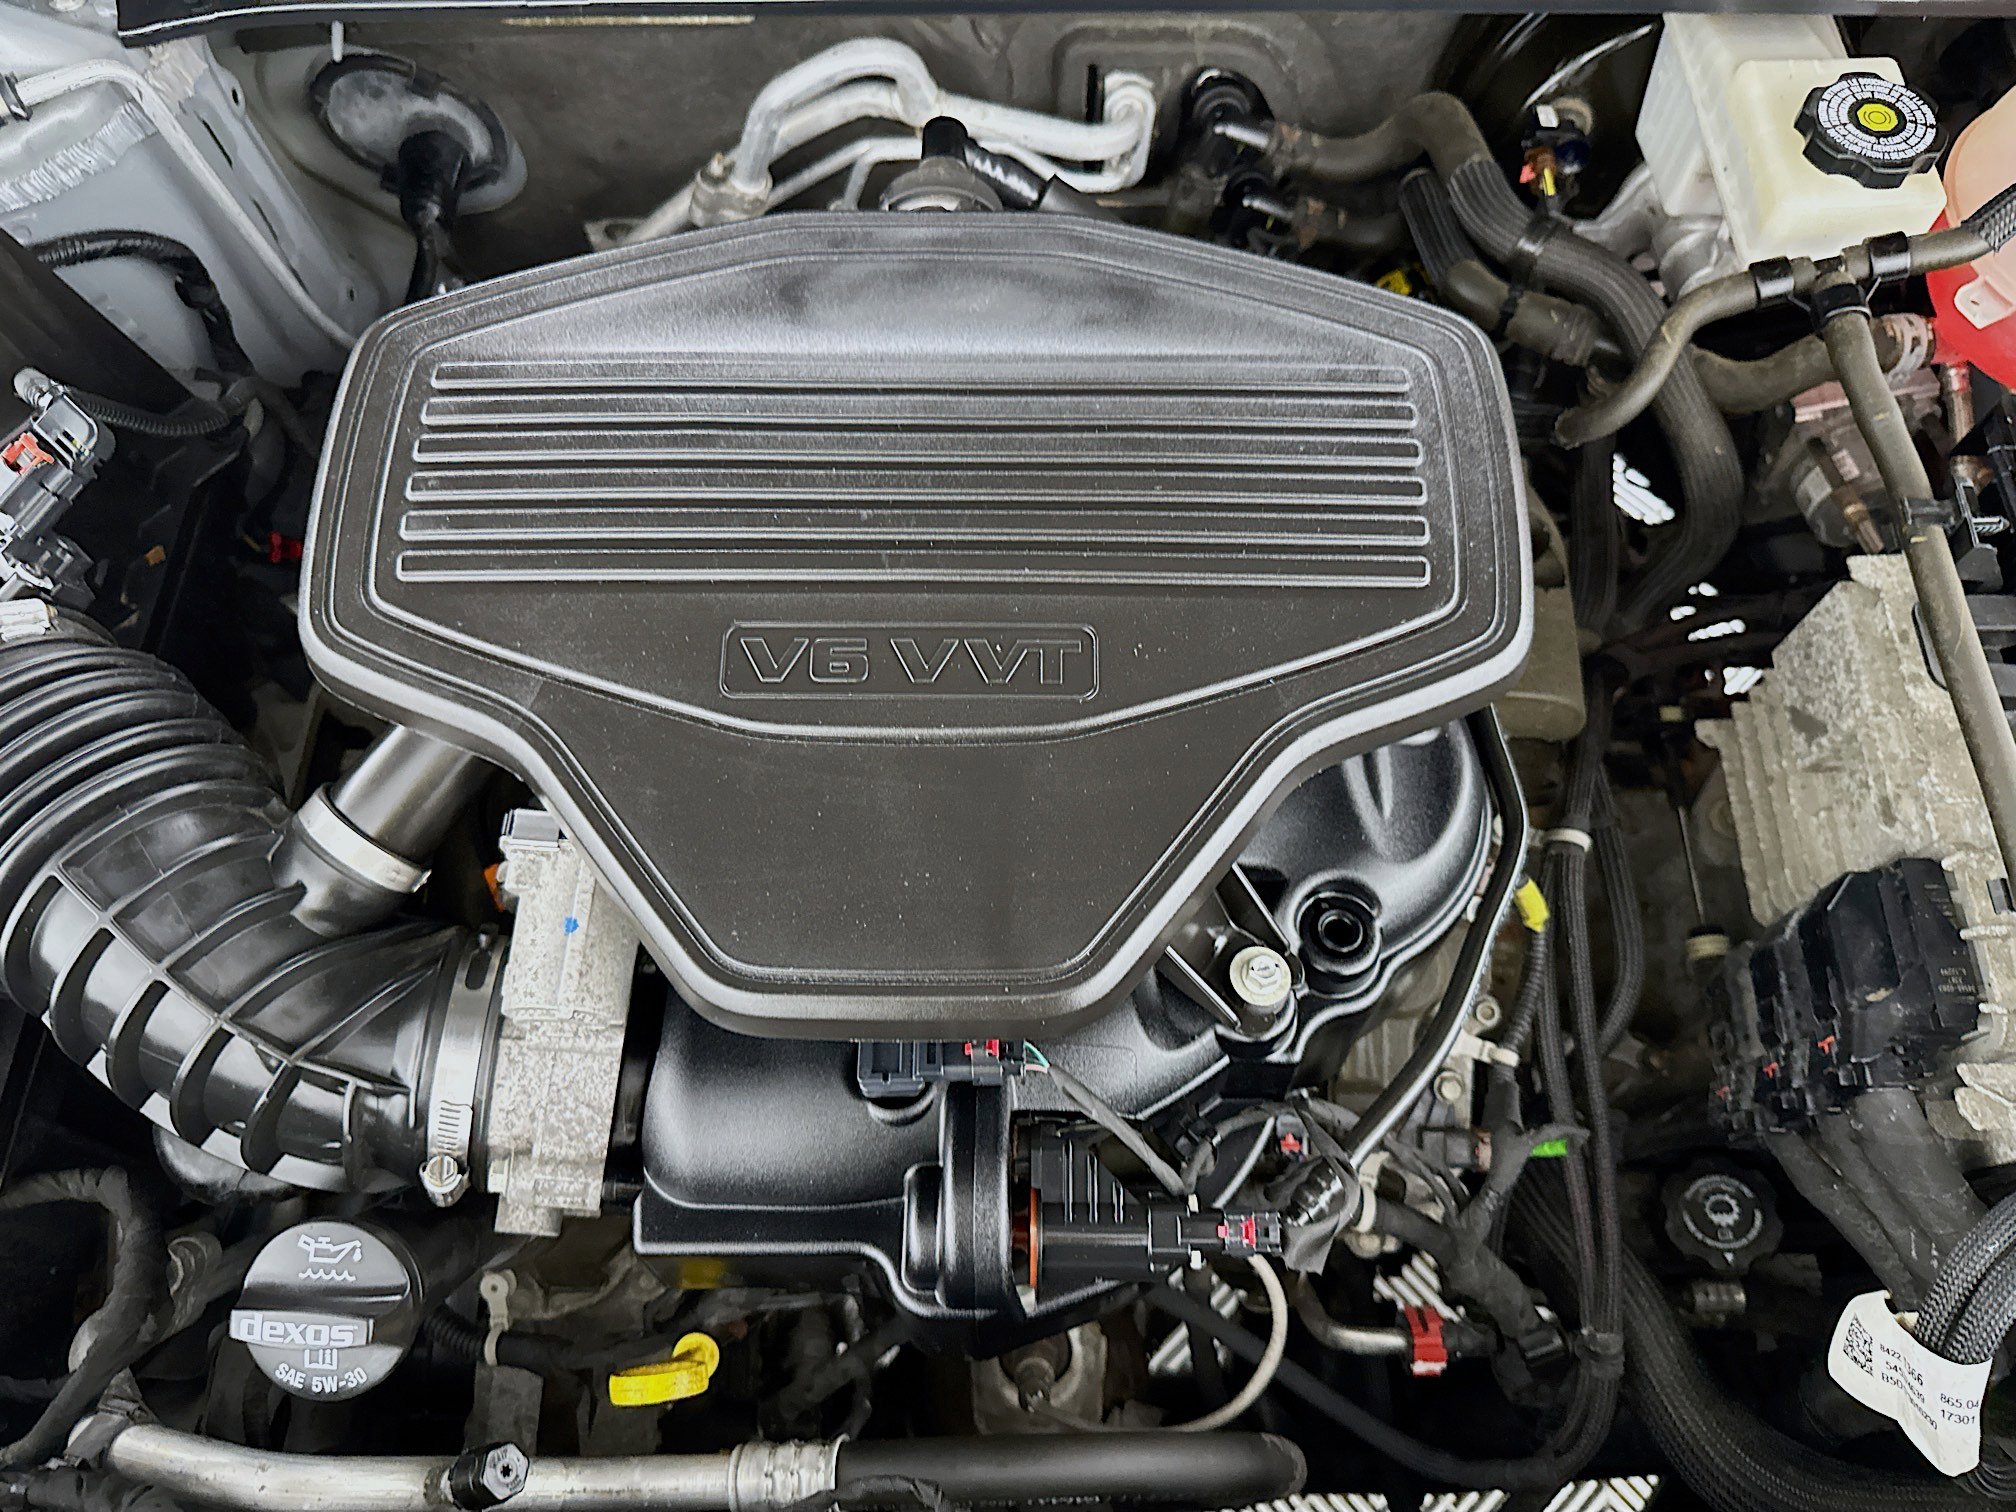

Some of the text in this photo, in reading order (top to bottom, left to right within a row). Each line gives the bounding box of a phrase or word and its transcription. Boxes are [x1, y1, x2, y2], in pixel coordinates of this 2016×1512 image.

[740, 637, 1082, 685] V6 VVT
[239, 1312, 355, 1347] dexos
[275, 1362, 368, 1393] SAE 5W-30
[1940, 1409, 1976, 1425] 17301
